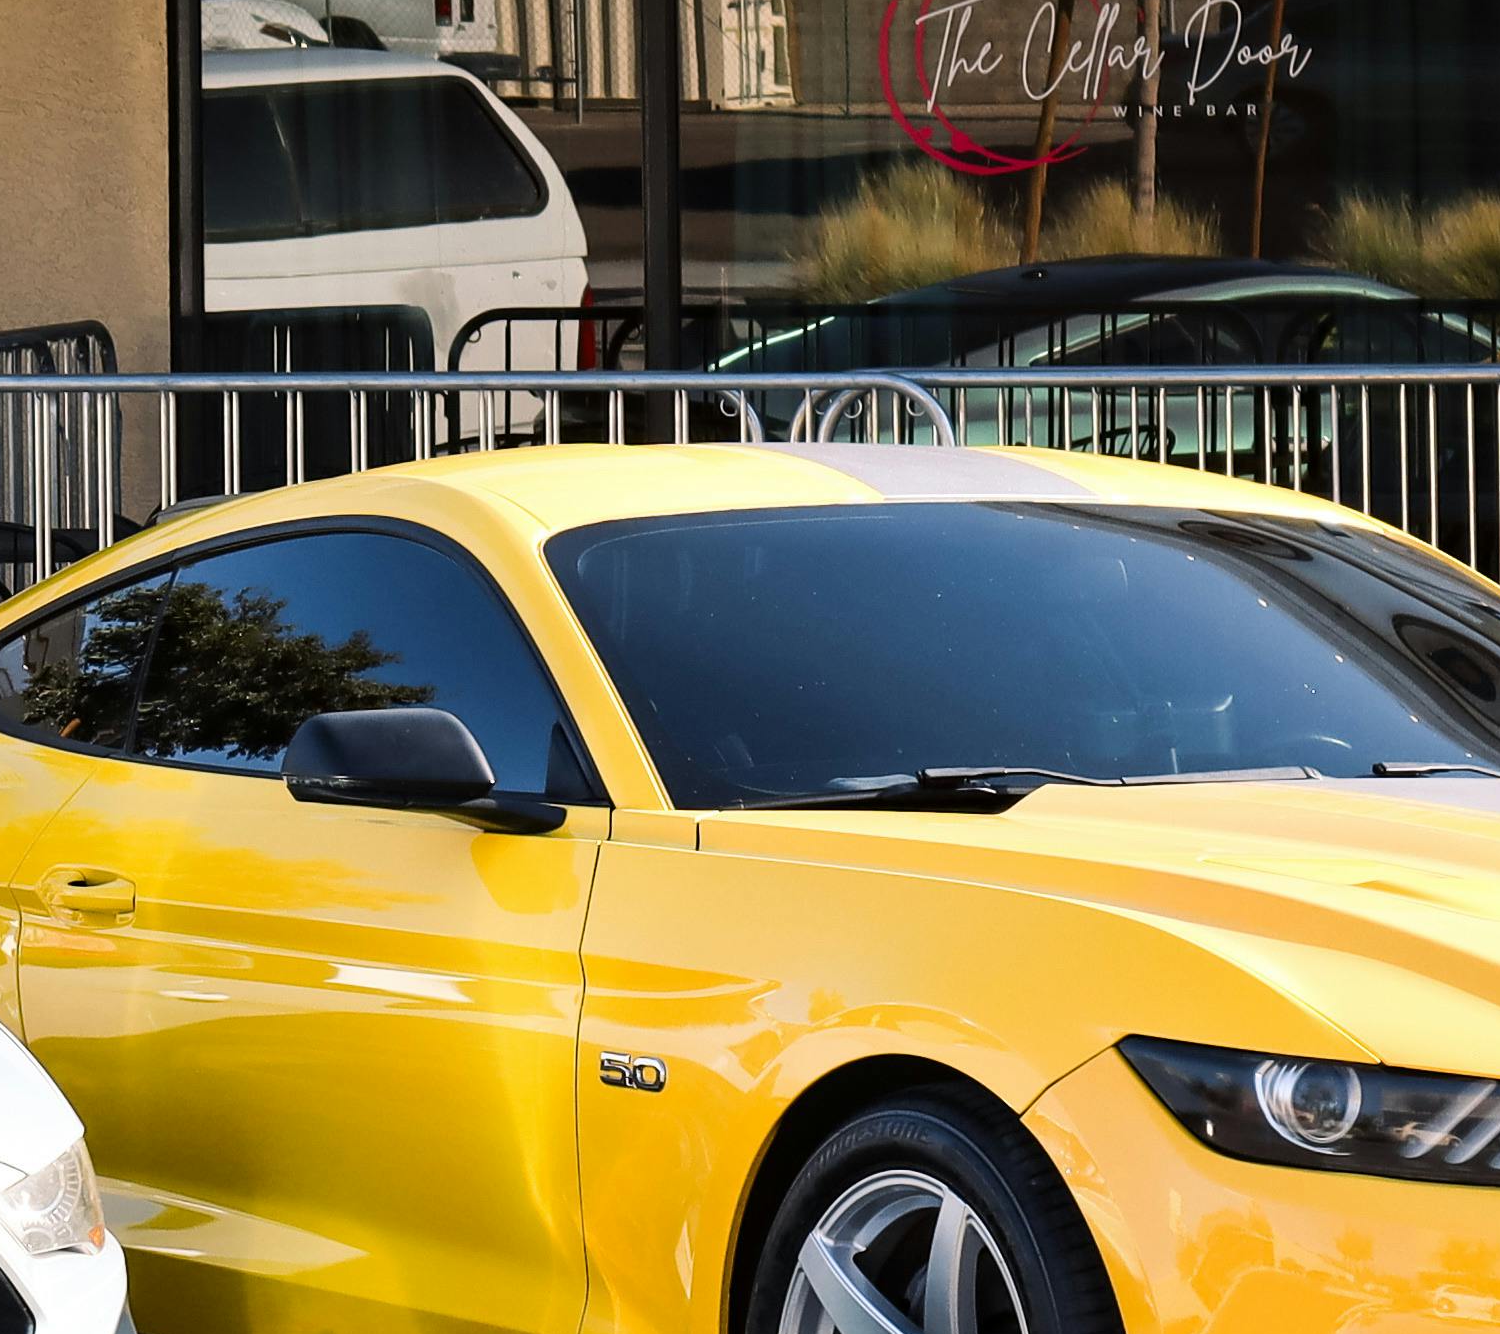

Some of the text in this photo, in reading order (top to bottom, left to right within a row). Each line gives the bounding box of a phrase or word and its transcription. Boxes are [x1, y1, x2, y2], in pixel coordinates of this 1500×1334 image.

[1021, 1, 1165, 101] Cellar
[1112, 104, 1258, 118] WINE BAR
